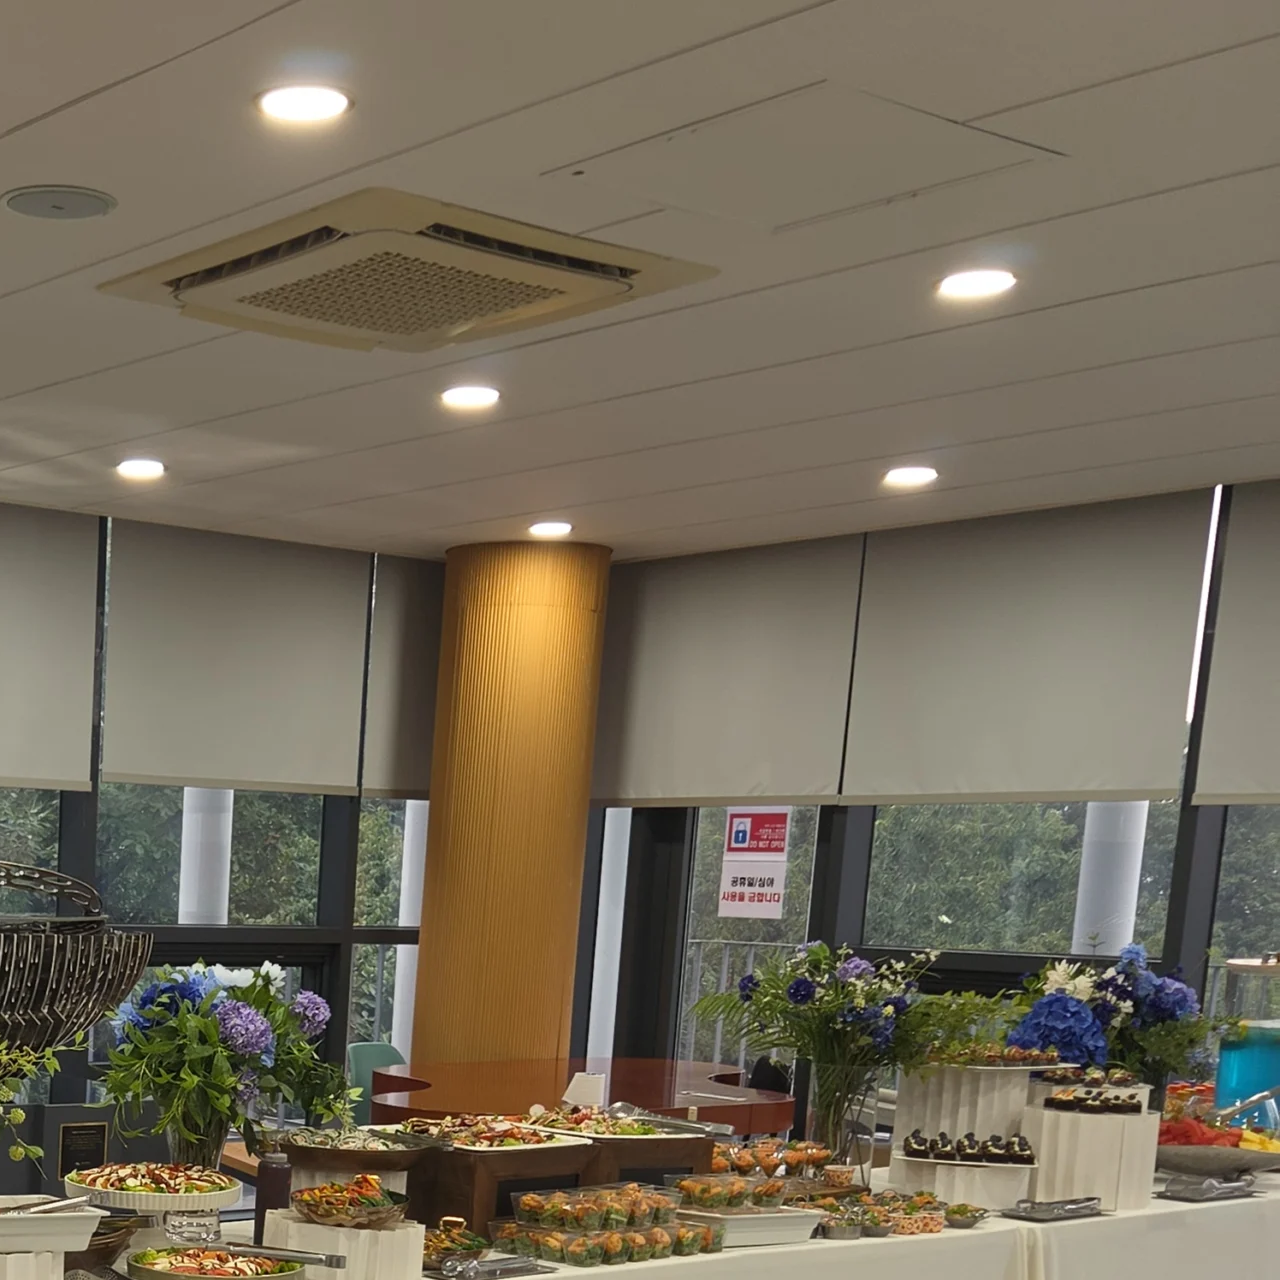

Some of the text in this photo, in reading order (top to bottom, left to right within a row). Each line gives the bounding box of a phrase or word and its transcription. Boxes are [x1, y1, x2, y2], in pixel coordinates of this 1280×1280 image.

[758, 840, 770, 848] NOT
[771, 840, 784, 848] OPEN
[731, 876, 774, 888] 공휴일/심야
[722, 891, 780, 903] 사용을 금합니다
